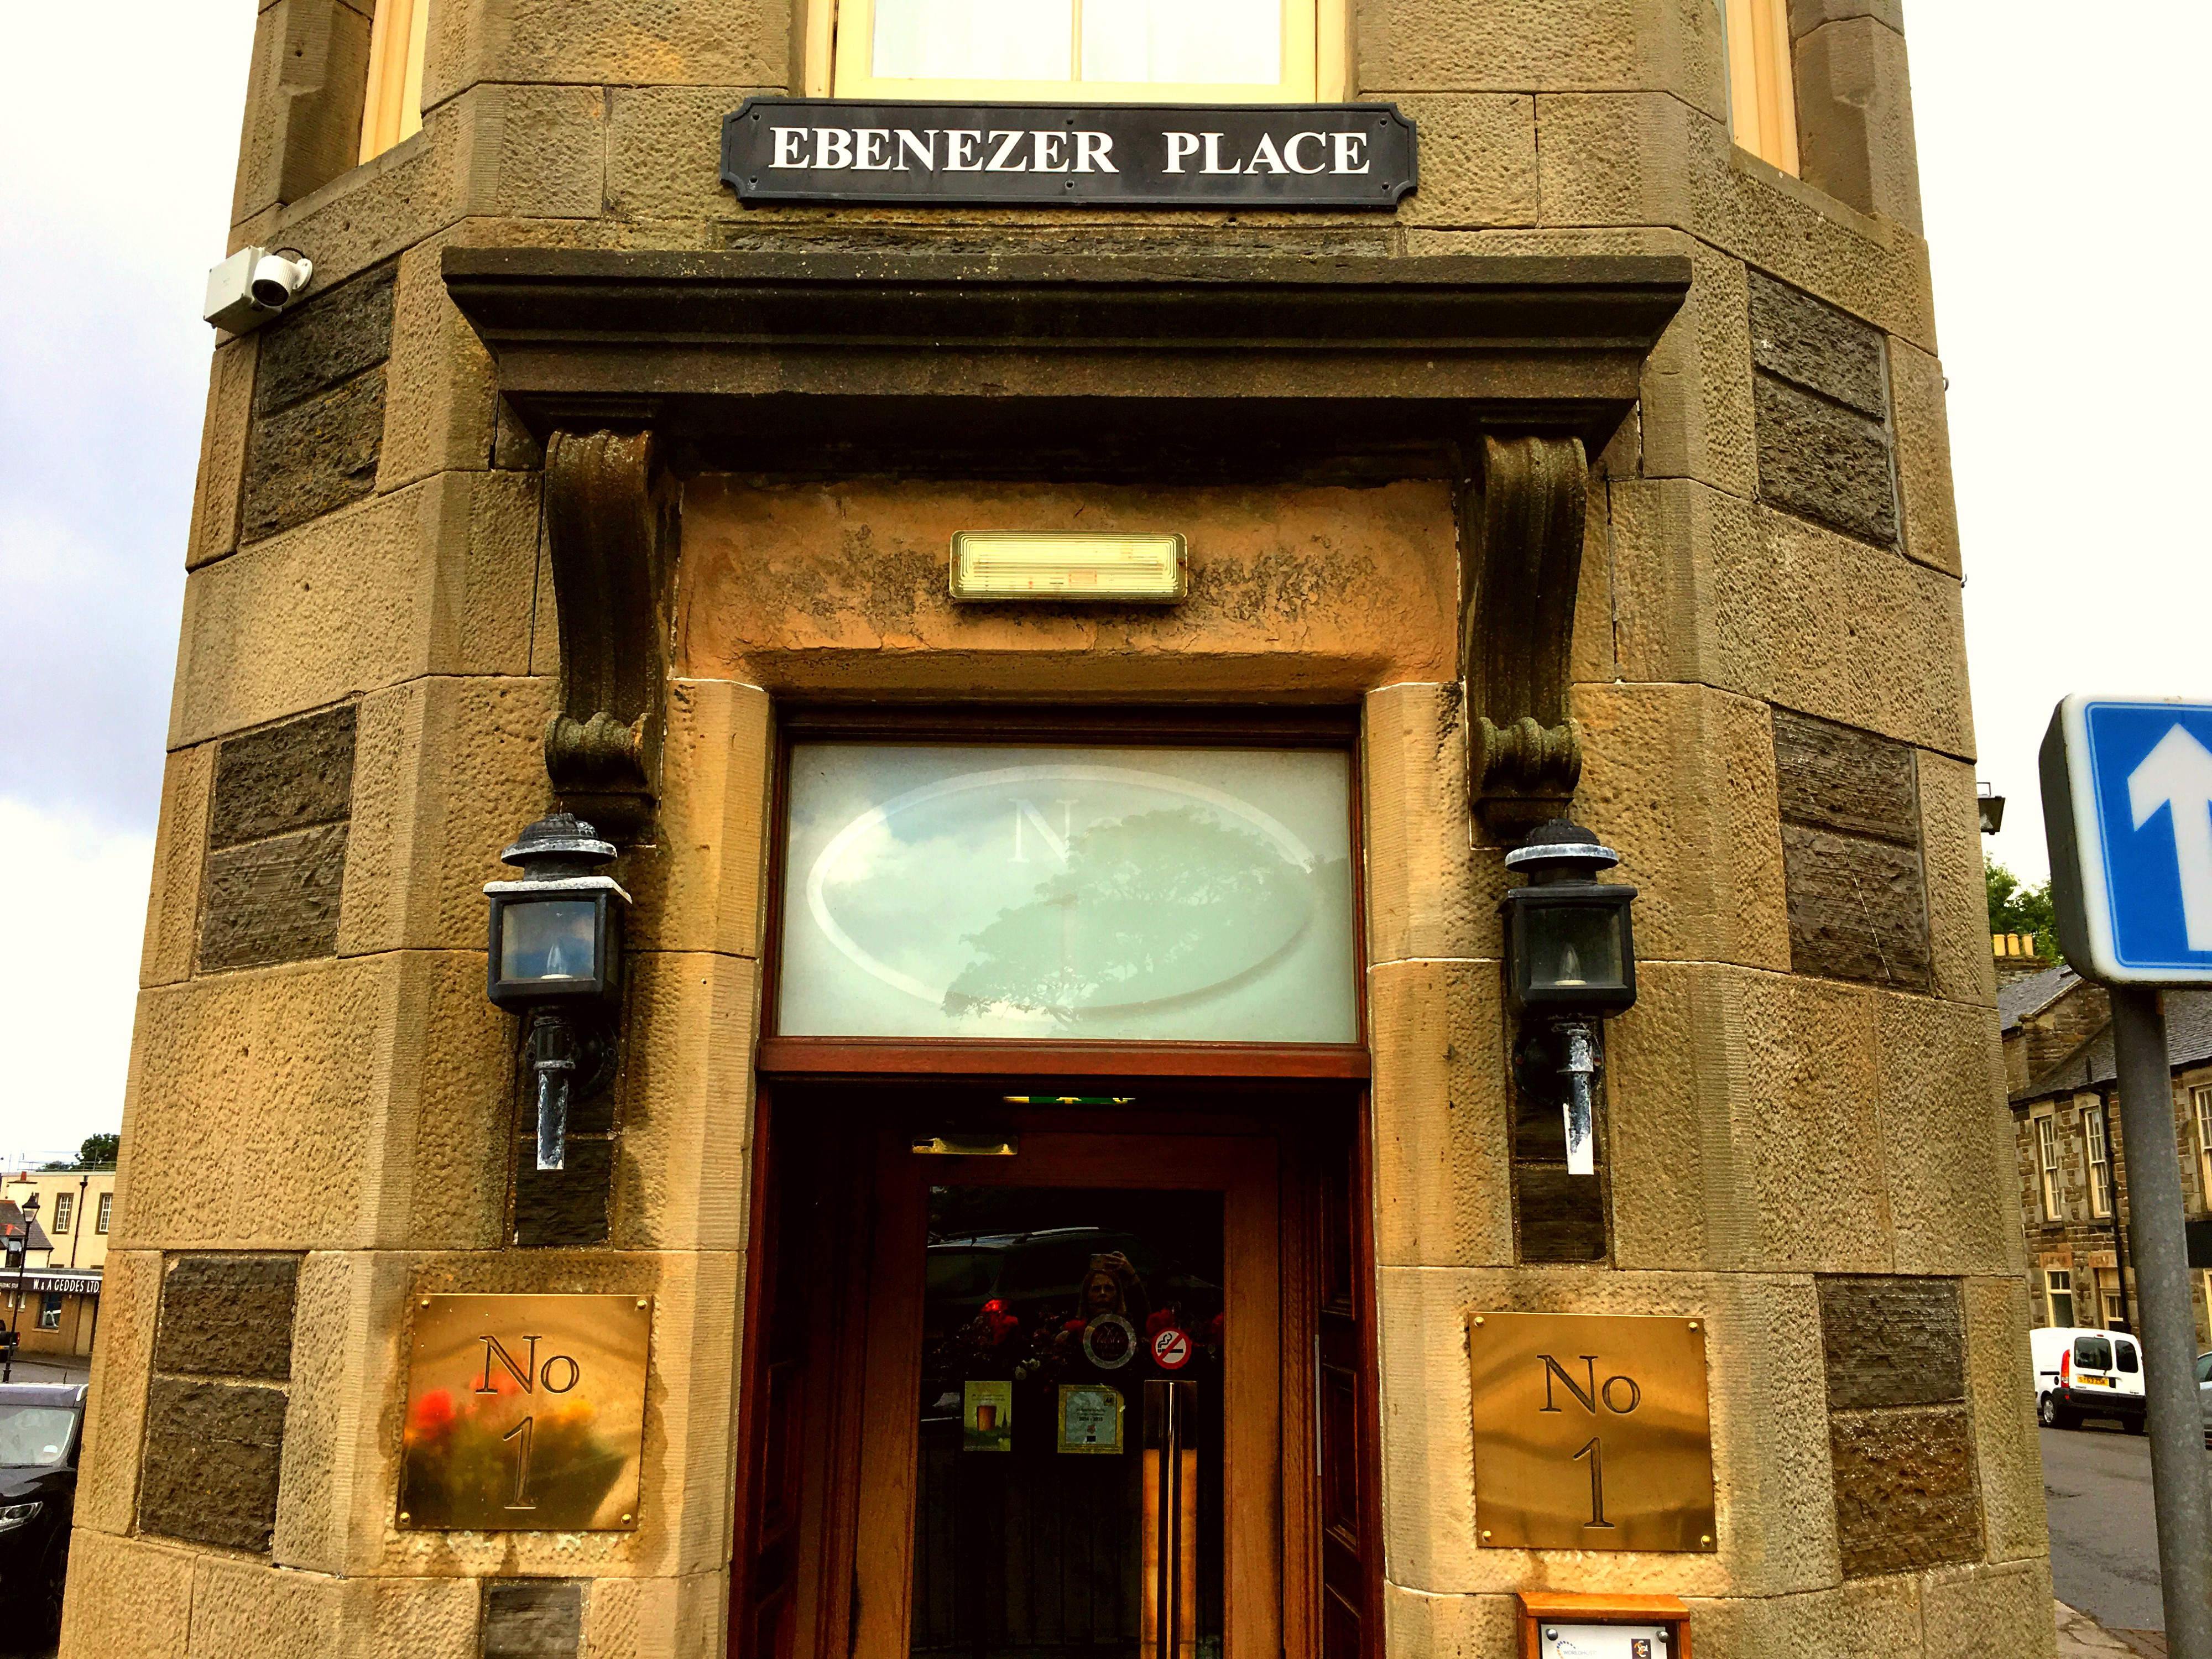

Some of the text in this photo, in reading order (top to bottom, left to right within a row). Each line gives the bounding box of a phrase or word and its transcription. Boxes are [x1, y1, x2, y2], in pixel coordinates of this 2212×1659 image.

[769, 128, 1369, 174] EBENEZER PLACE
[41, 1282, 45, 1290] &
[46, 1279, 52, 1290] A
[54, 1279, 84, 1292] GEDDES
[86, 1281, 100, 1293] LTD.
[476, 1335, 580, 1395] No
[1537, 1355, 1641, 1414] No
[503, 1416, 536, 1509] 1
[1573, 1437, 1614, 1527] 1
